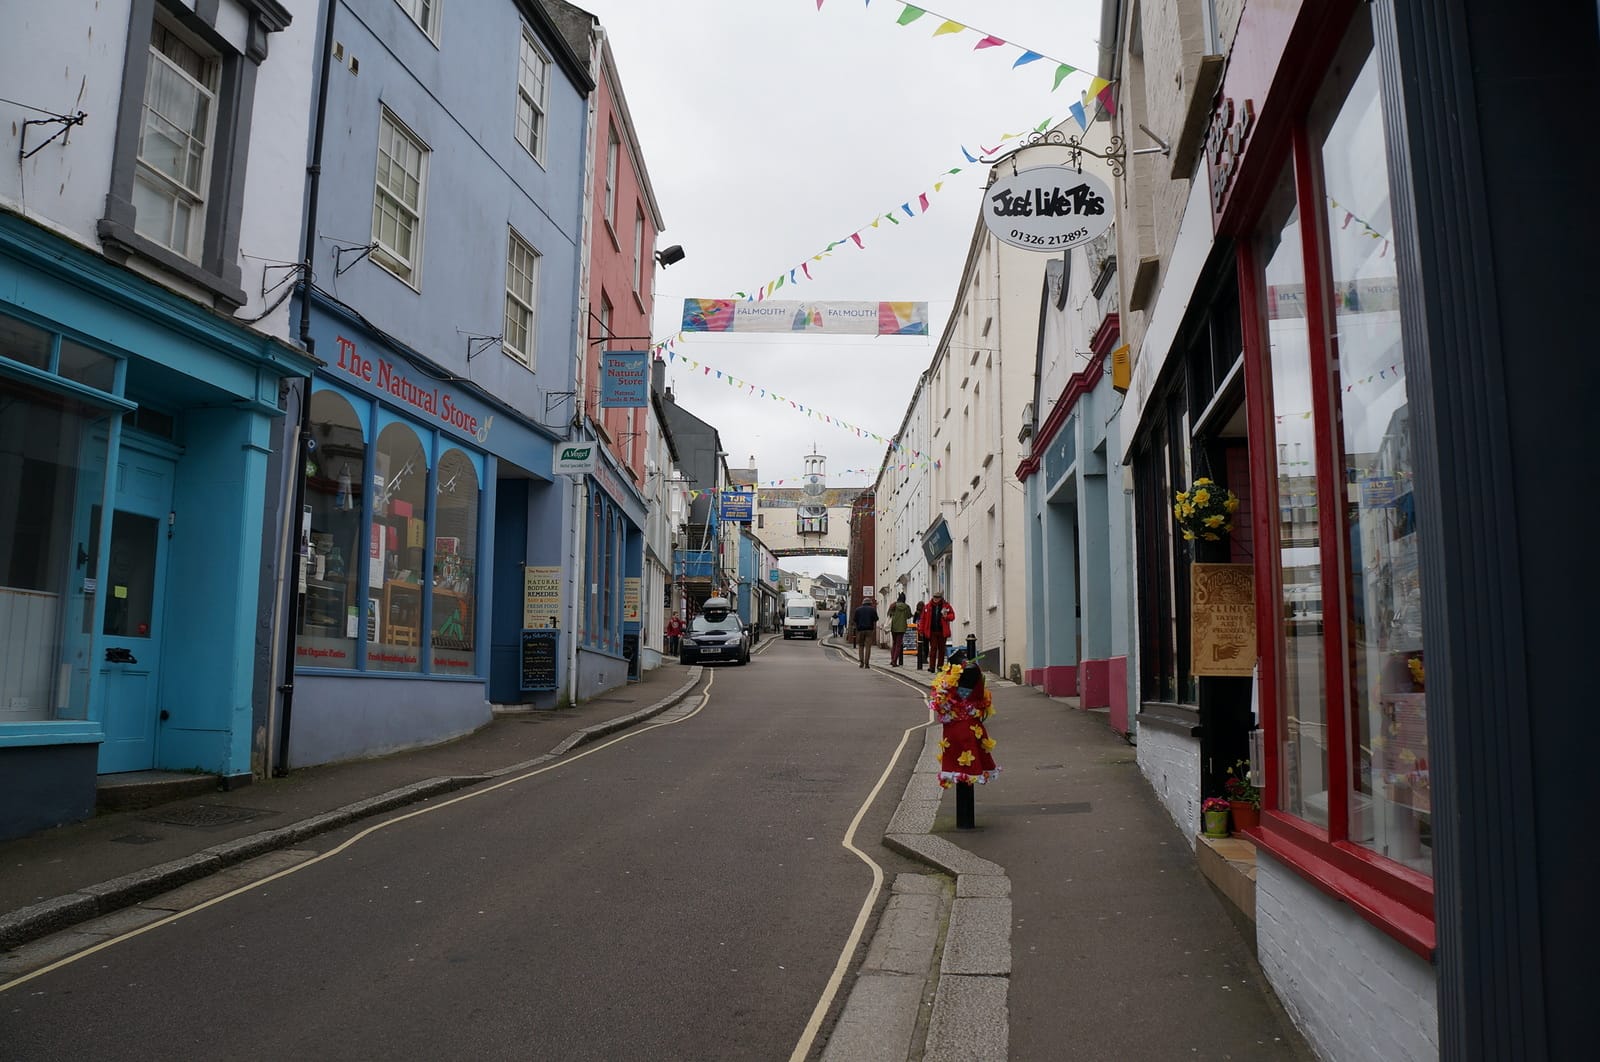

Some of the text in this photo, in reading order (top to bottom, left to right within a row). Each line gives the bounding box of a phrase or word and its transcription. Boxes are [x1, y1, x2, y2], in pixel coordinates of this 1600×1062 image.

[992, 182, 1105, 217] Just Like This
[1010, 226, 1088, 245] 01326 212895
[737, 307, 877, 317] FALMOUTH FALMOUTH
[608, 359, 625, 367] The
[608, 368, 644, 377] Natural
[336, 335, 478, 436] The Natural Store
[1209, 605, 1249, 613] CLINIC
